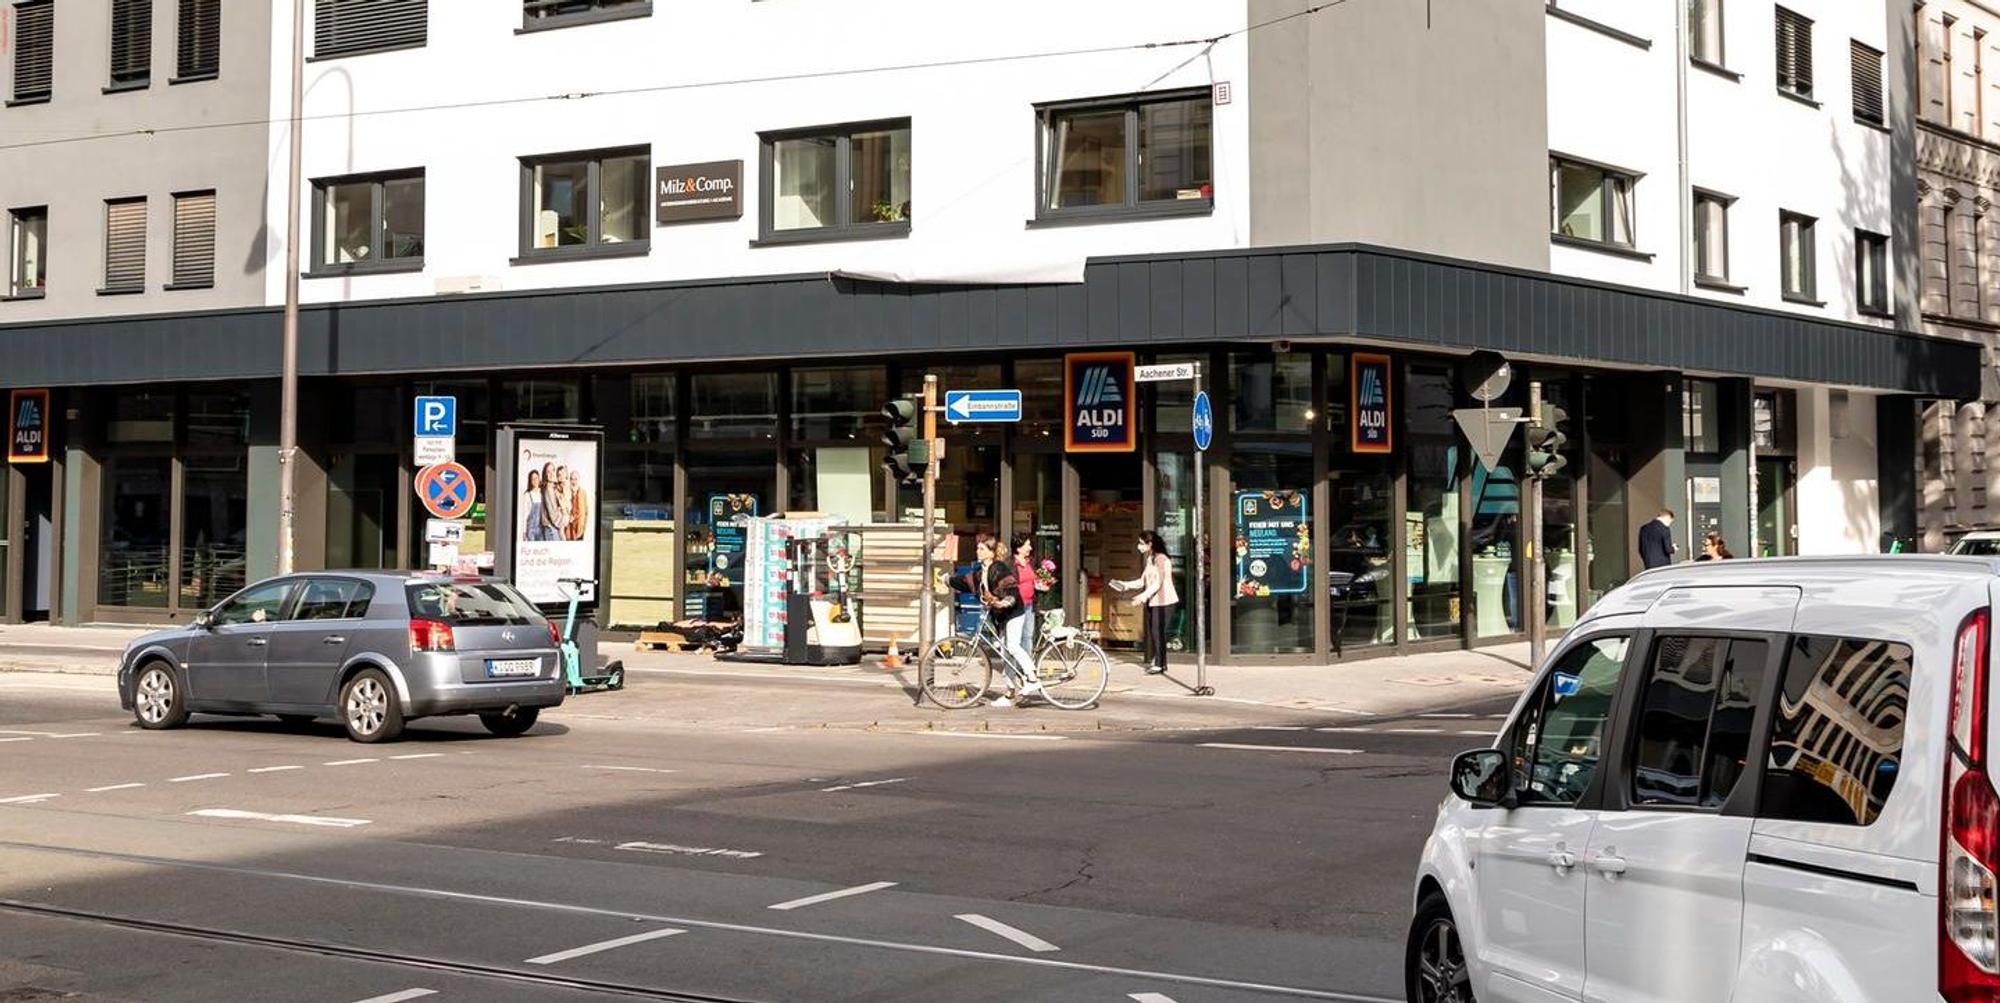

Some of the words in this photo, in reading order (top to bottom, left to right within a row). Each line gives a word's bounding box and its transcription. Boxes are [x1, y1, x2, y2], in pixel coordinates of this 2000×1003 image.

[660, 176, 733, 194] Milz&Comp.
[1140, 369, 1175, 378] Aachener
[1176, 366, 1189, 377] Str.
[425, 401, 446, 431] P
[1077, 409, 1123, 426] ALDI
[1360, 409, 1385, 427] ALDI
[16, 430, 41, 443] ALDI
[1091, 426, 1109, 438] SÜD
